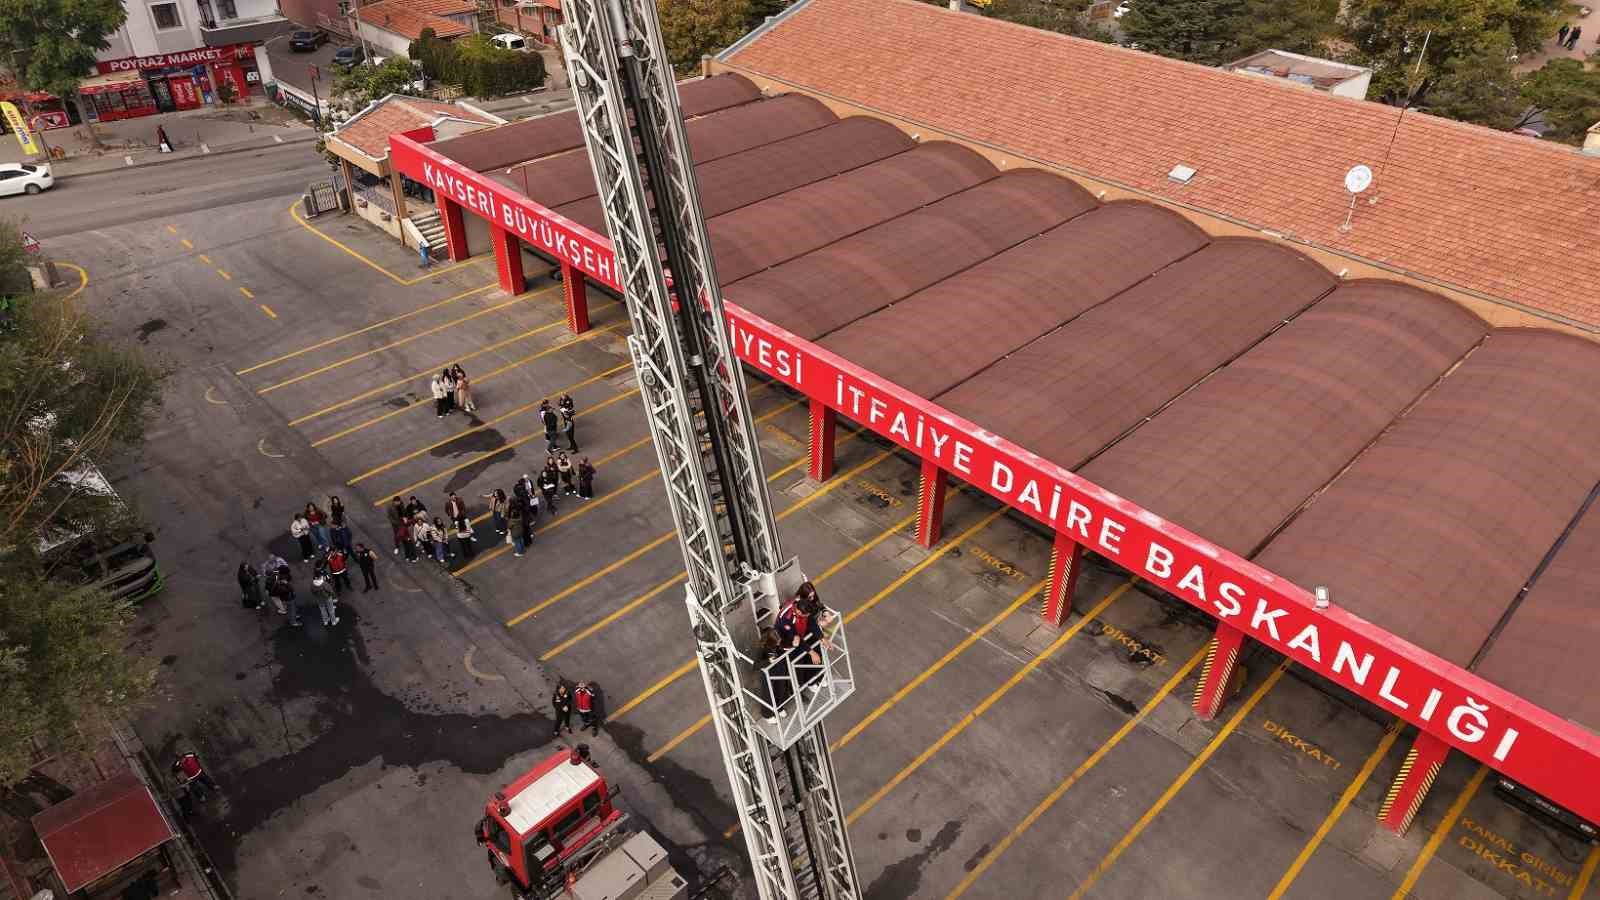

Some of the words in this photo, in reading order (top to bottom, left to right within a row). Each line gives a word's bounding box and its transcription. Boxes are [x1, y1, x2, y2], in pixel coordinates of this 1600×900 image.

[110, 56, 166, 71] POYRAZ
[168, 49, 222, 65] MARKET
[423, 162, 497, 218] KAYSERİ
[502, 203, 620, 285] BÜYÜKŞEHİ
[730, 319, 802, 385] İYESİ
[836, 374, 975, 475] İTFAİYE
[991, 460, 1127, 555] DAİRE
[1144, 542, 1520, 762] BAŞKANLIĞI
